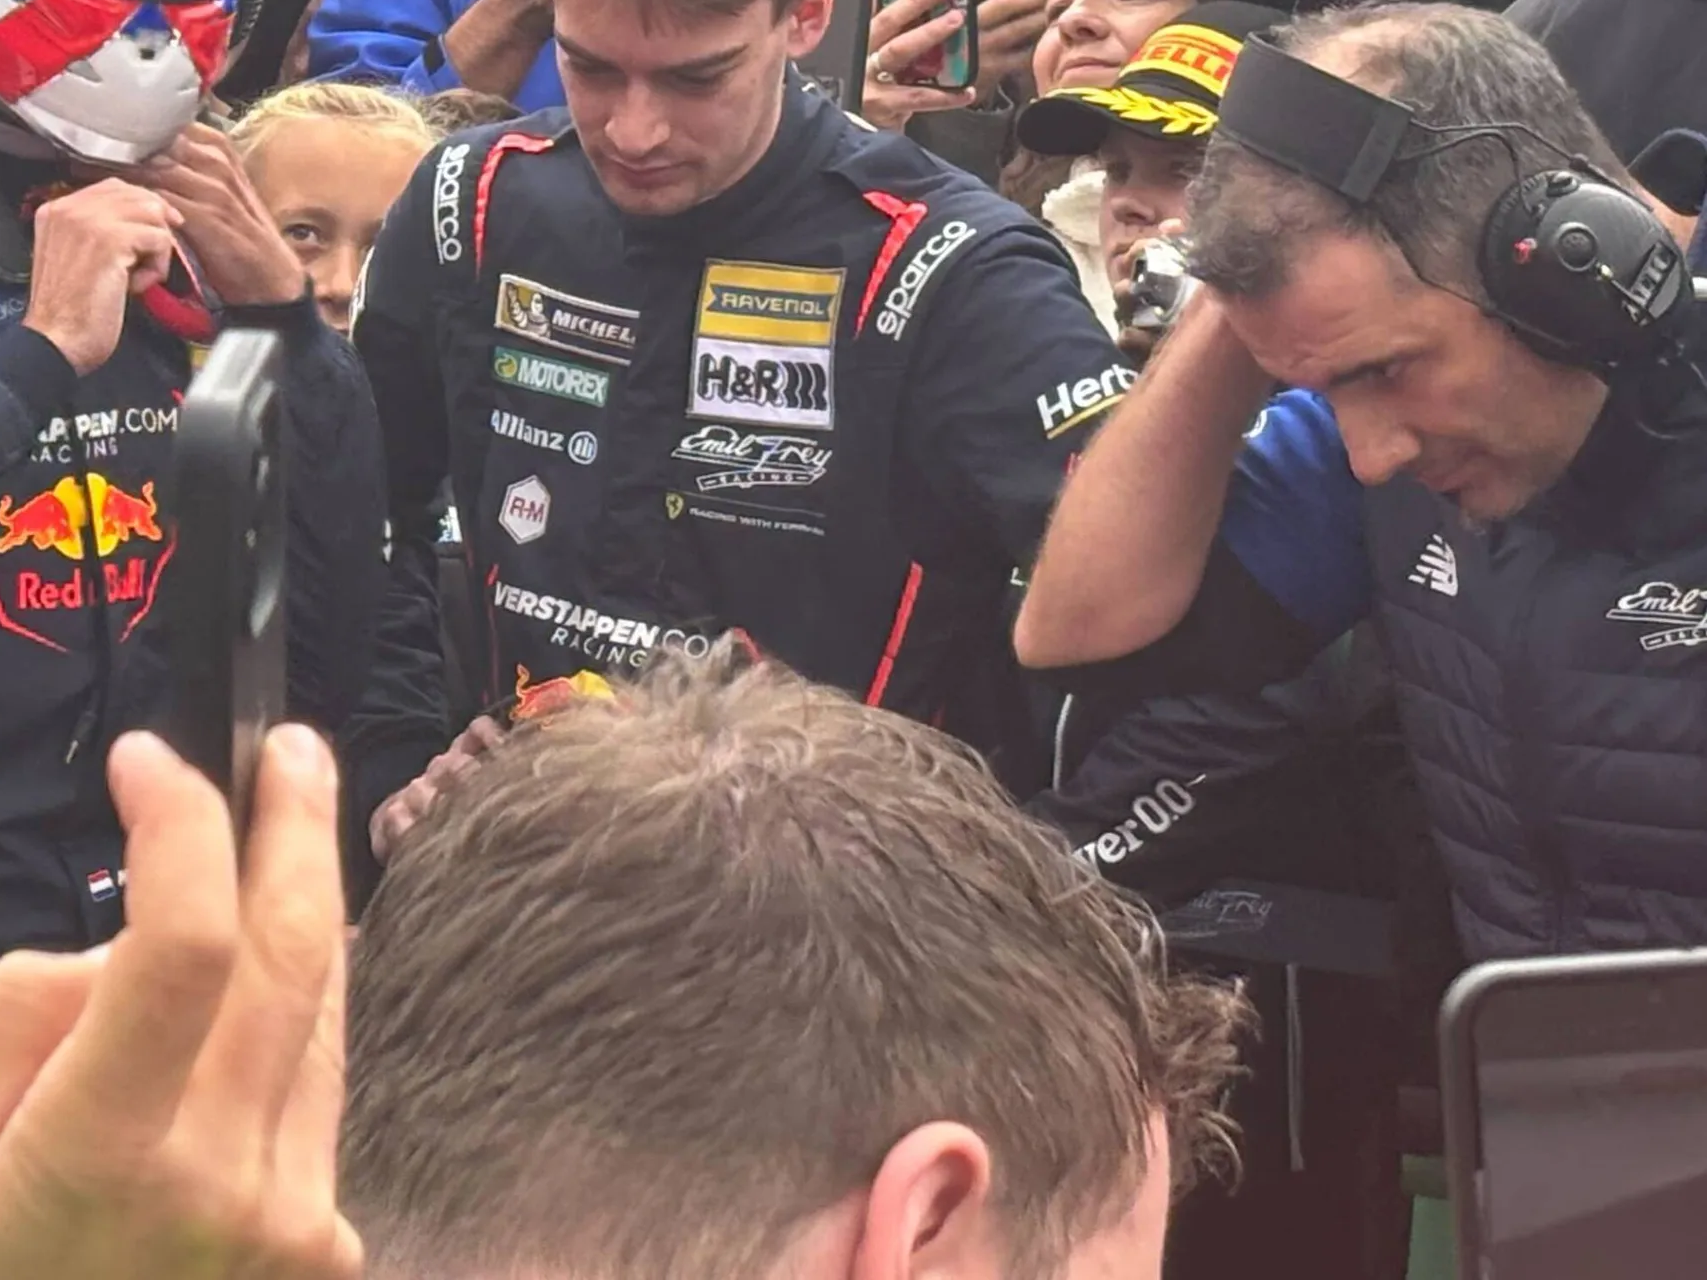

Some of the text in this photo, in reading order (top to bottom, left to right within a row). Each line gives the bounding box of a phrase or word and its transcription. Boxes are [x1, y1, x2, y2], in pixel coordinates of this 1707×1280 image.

[1141, 45, 1232, 82] ELLI
[432, 143, 471, 265] sparco
[876, 220, 977, 341] sparco
[551, 308, 636, 343] MICHEL
[721, 292, 825, 316] RAVENOL
[516, 356, 609, 404] MOTOREX
[30, 436, 119, 464] ACING
[490, 409, 566, 452] Allianz
[680, 424, 834, 480] Emil Frey
[17, 558, 147, 610] Red Bull
[1618, 581, 1700, 613] Emil
[550, 625, 648, 669] RACING
[1132, 779, 1196, 834] 0.0
